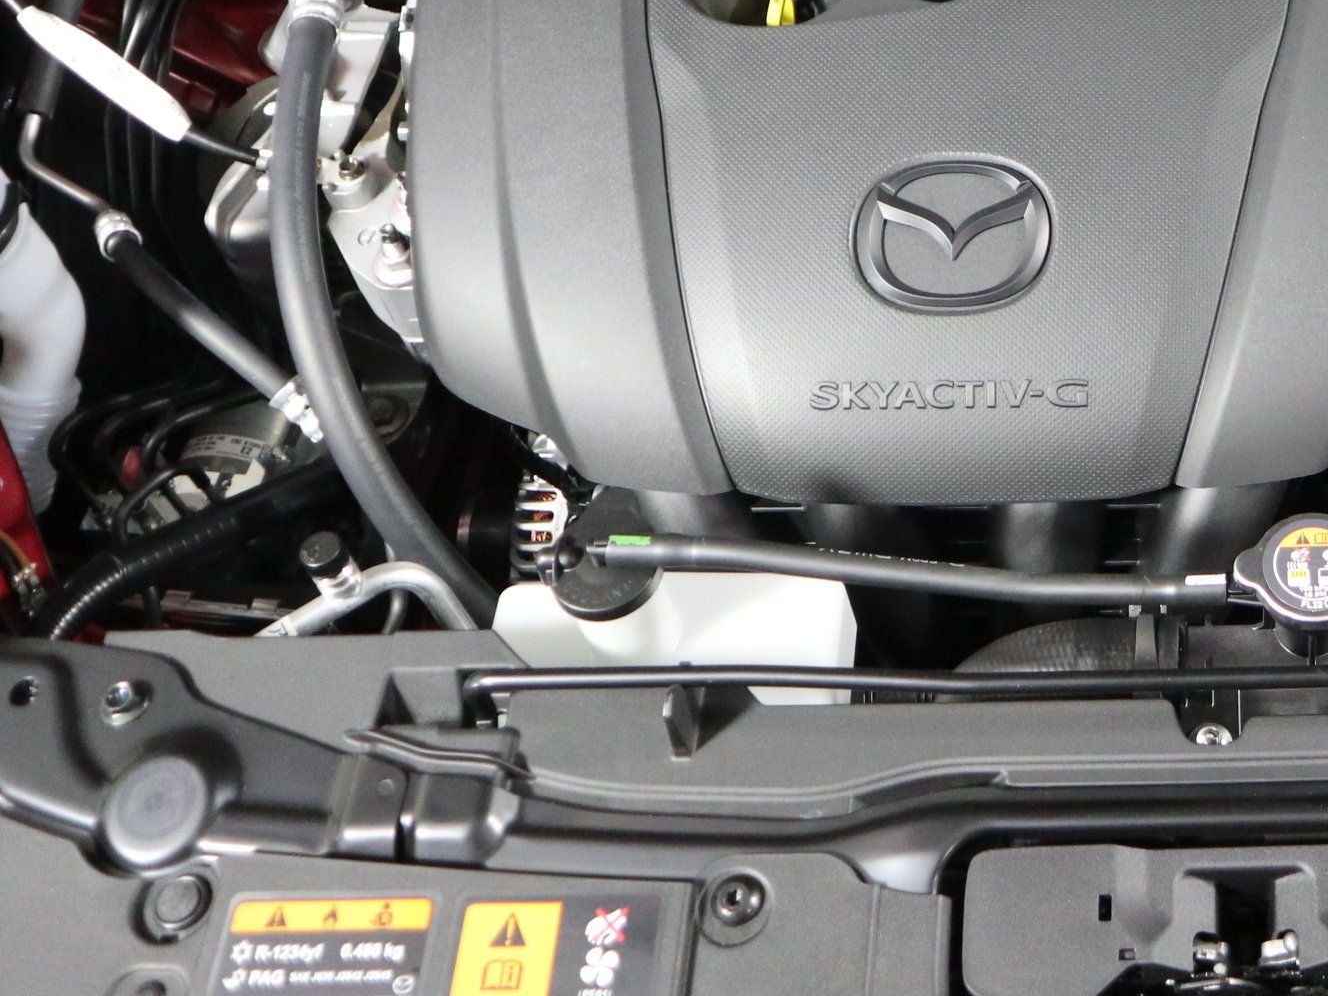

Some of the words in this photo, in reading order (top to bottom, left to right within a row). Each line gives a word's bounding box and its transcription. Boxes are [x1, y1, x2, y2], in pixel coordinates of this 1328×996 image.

[808, 378, 1090, 410] SKYACTIV-G
[382, 942, 405, 964] kg
[247, 969, 286, 989] PAG
